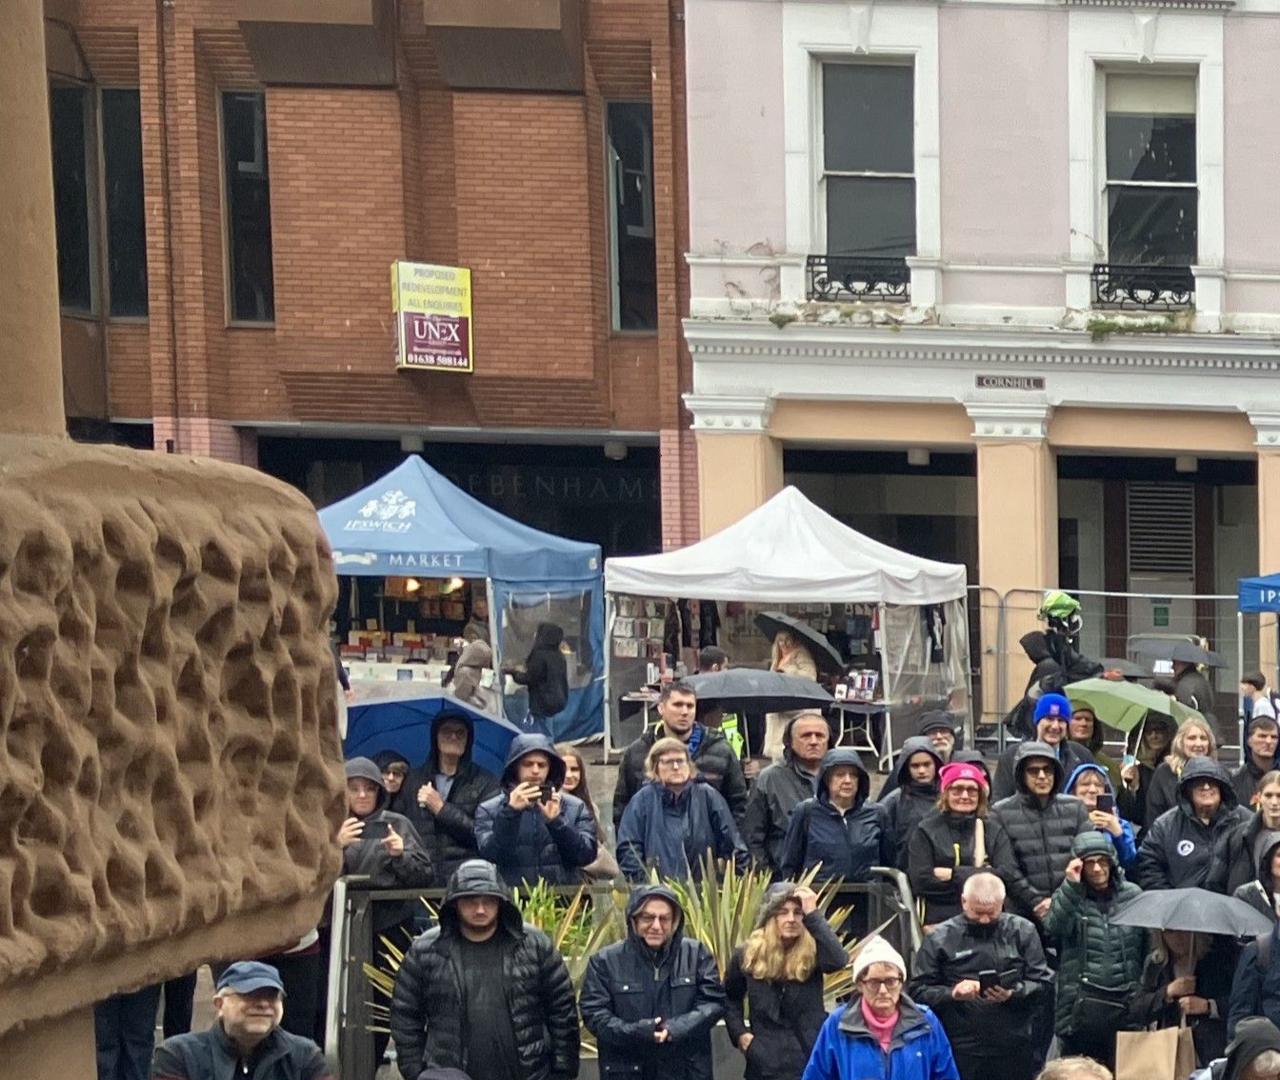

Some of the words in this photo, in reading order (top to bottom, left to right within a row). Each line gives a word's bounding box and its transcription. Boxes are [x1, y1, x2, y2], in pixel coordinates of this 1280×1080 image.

[414, 320, 460, 342] UNEX
[983, 377, 1037, 388] CORNHILL
[344, 519, 412, 533] IPSWICH
[389, 554, 463, 567] MARKET
